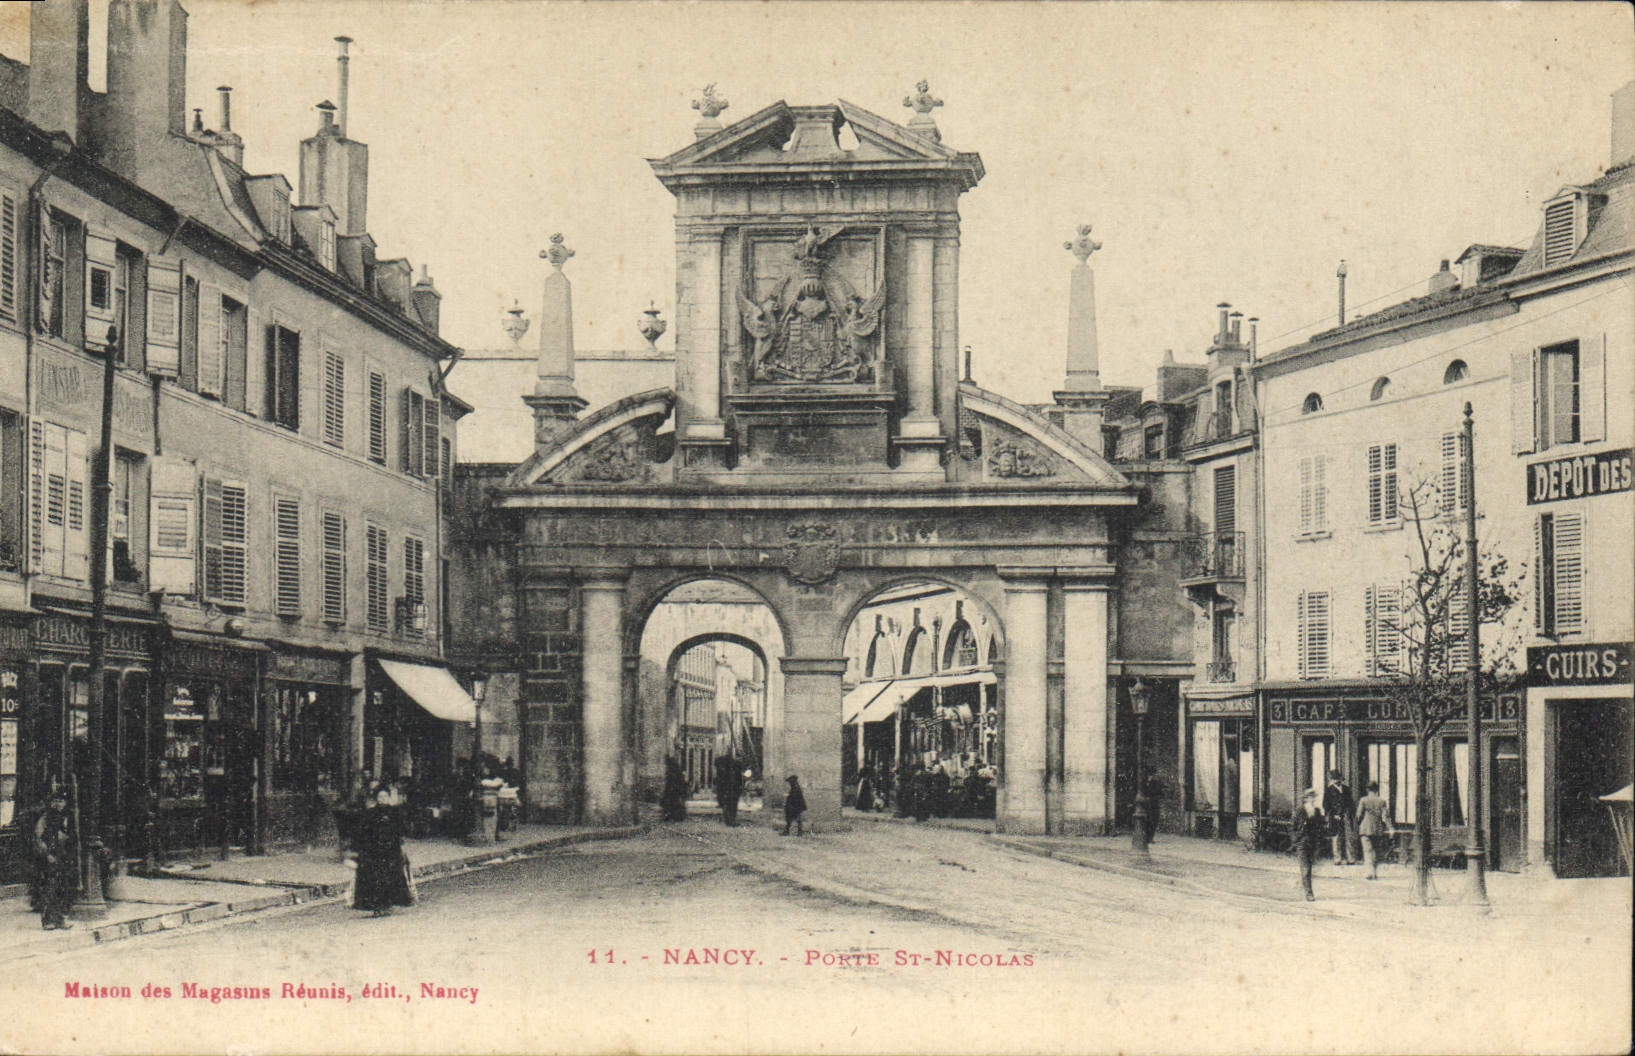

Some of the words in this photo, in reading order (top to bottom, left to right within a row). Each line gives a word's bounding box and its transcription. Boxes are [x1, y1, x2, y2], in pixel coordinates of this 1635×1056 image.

[1599, 457, 1632, 492] DES
[1546, 649, 1617, 680] CUIRS
[1505, 701, 1516, 718] 3
